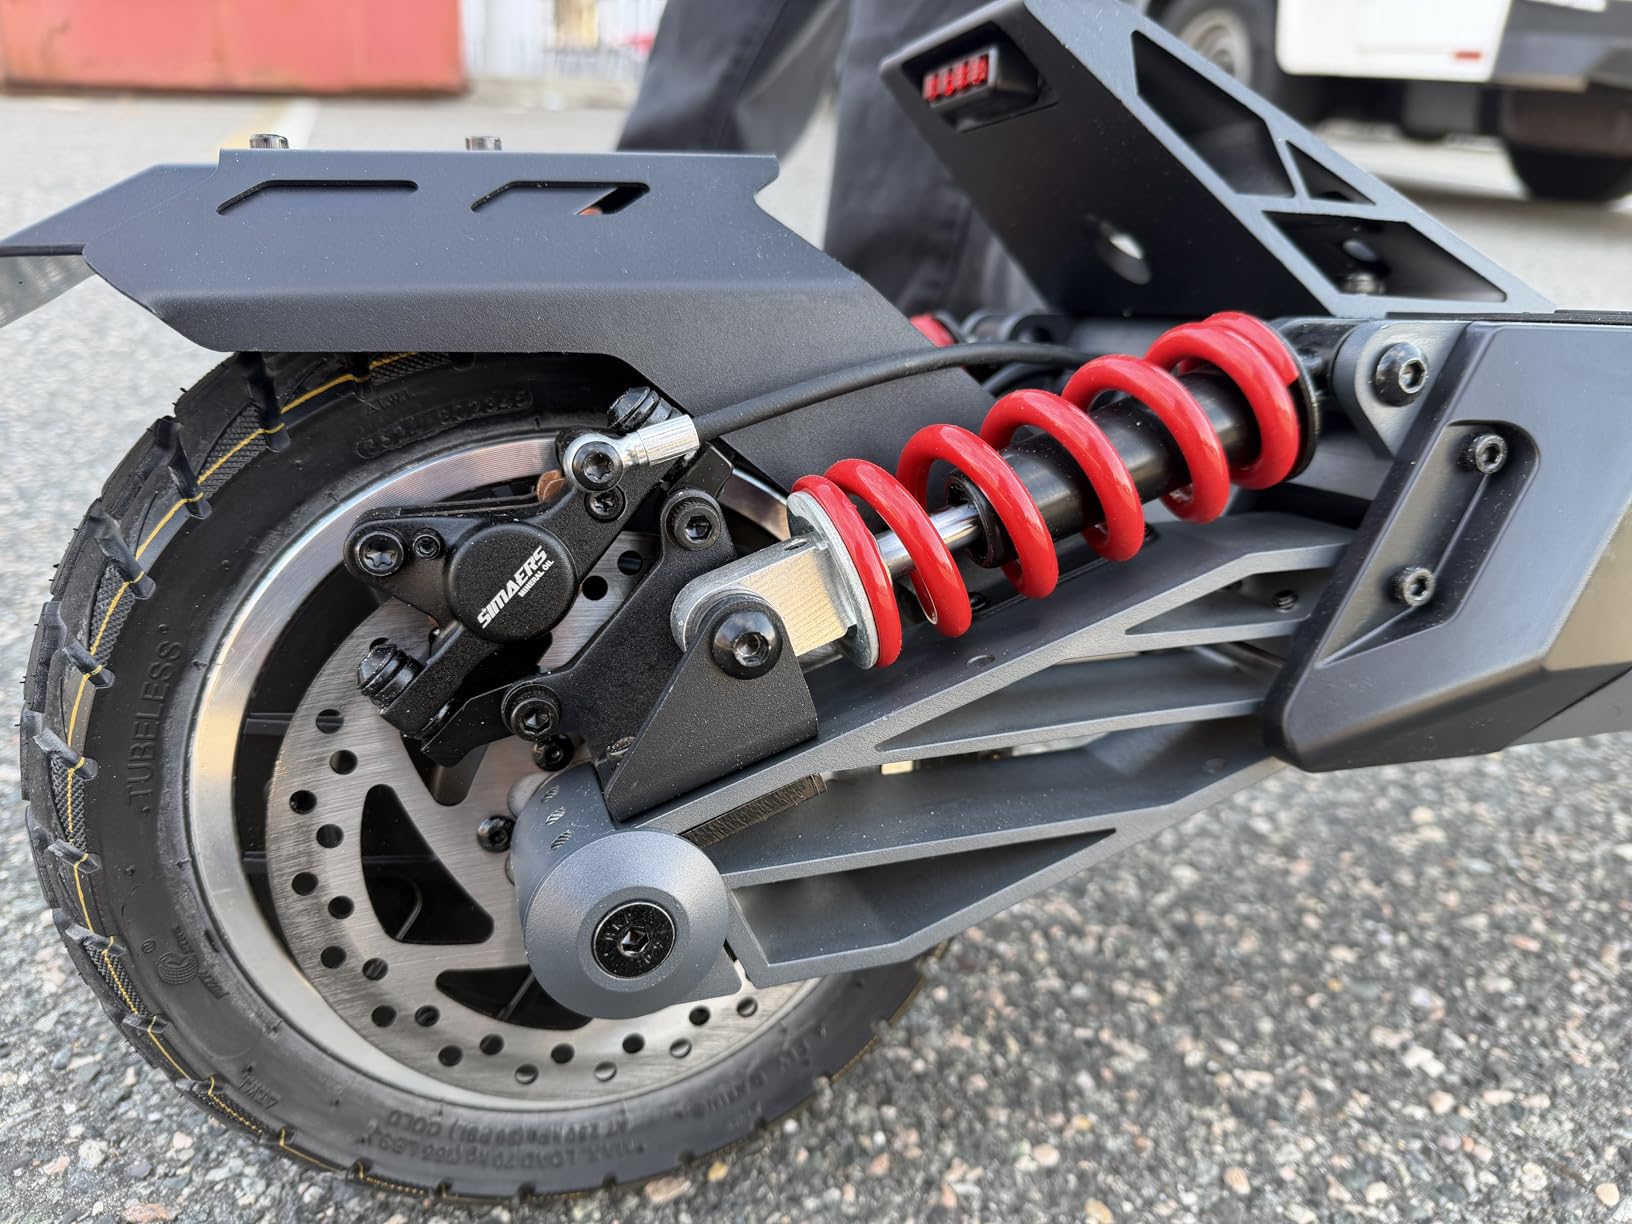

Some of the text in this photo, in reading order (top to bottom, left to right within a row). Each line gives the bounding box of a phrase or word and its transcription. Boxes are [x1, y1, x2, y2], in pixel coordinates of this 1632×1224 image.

[477, 545, 547, 629] SIMAERS
[518, 560, 555, 597] MINERAL OIL
[126, 641, 184, 806] TUBELESS
[387, 1110, 441, 1136] COLD
